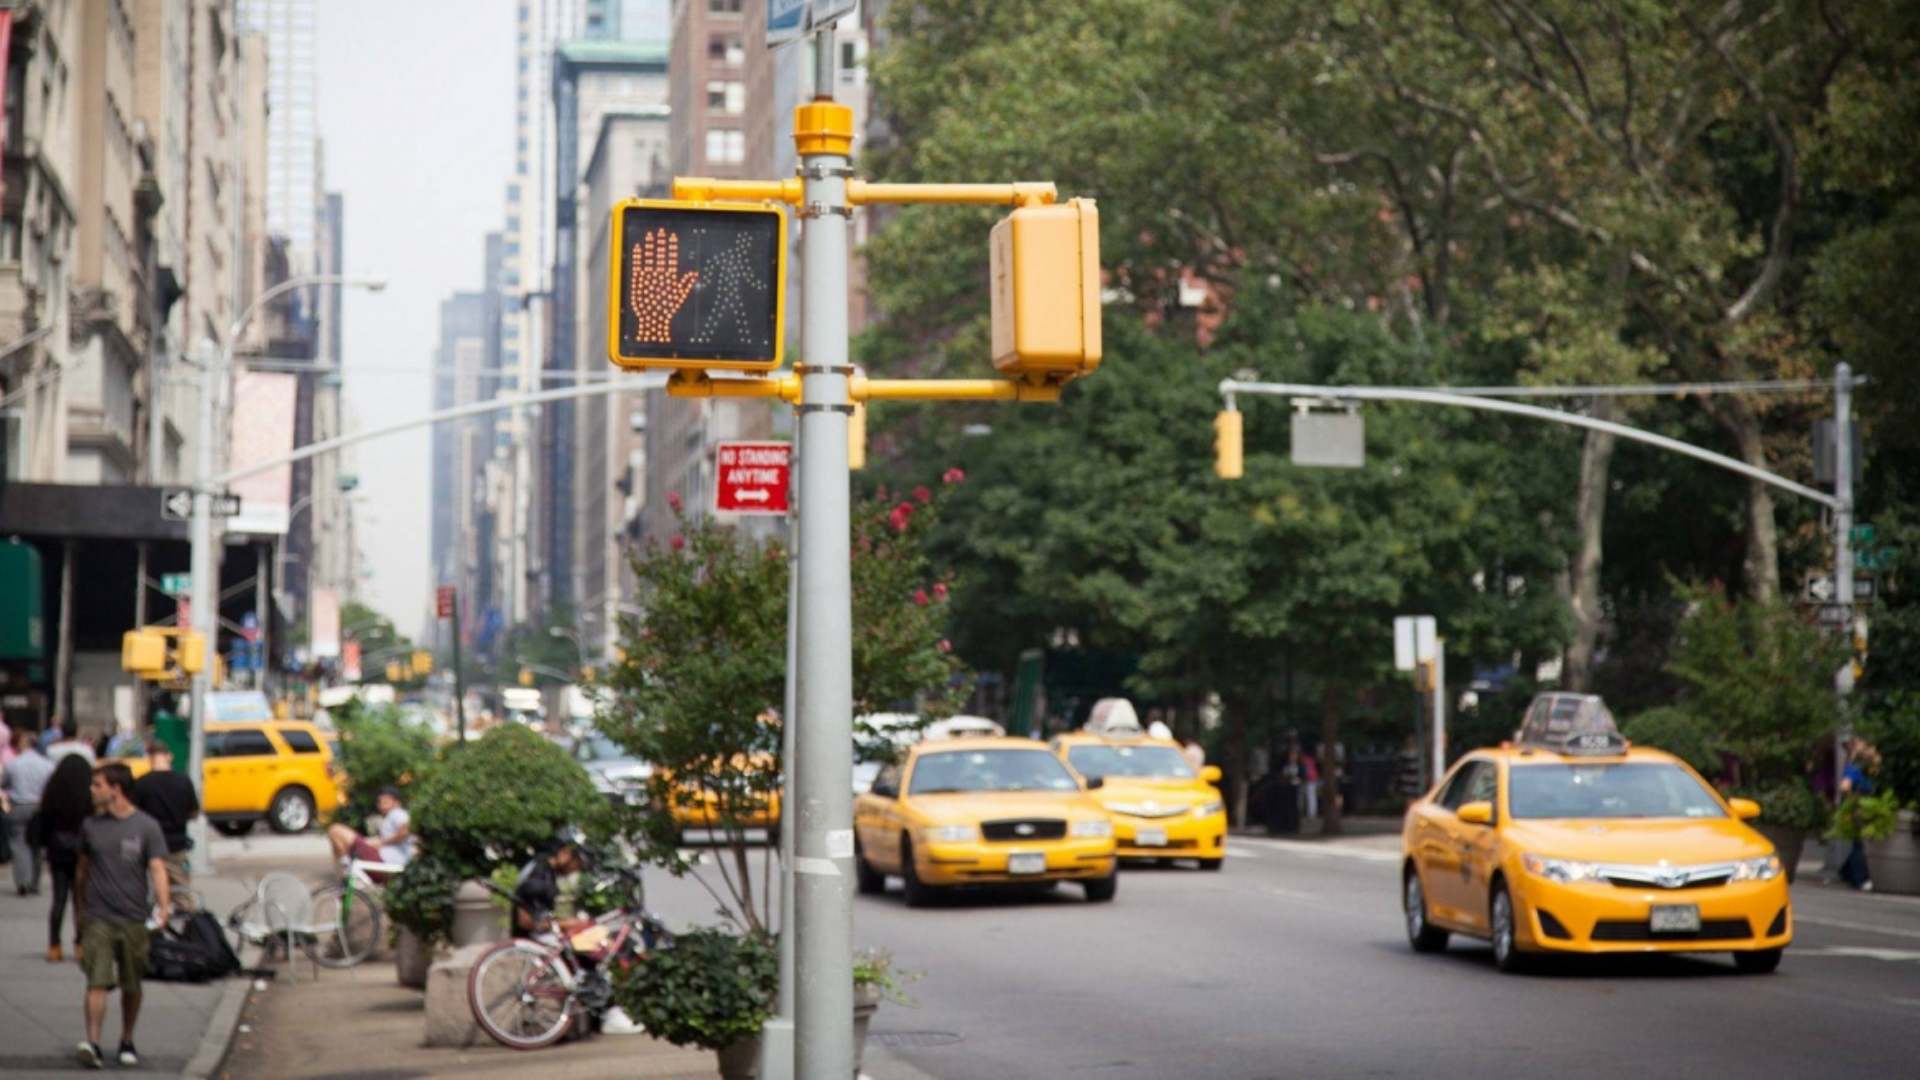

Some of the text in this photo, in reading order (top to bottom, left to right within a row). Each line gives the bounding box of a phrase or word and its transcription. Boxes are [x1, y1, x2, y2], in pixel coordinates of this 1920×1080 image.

[721, 449, 789, 466] NO STANDING
[727, 468, 780, 485] ANYTIME
